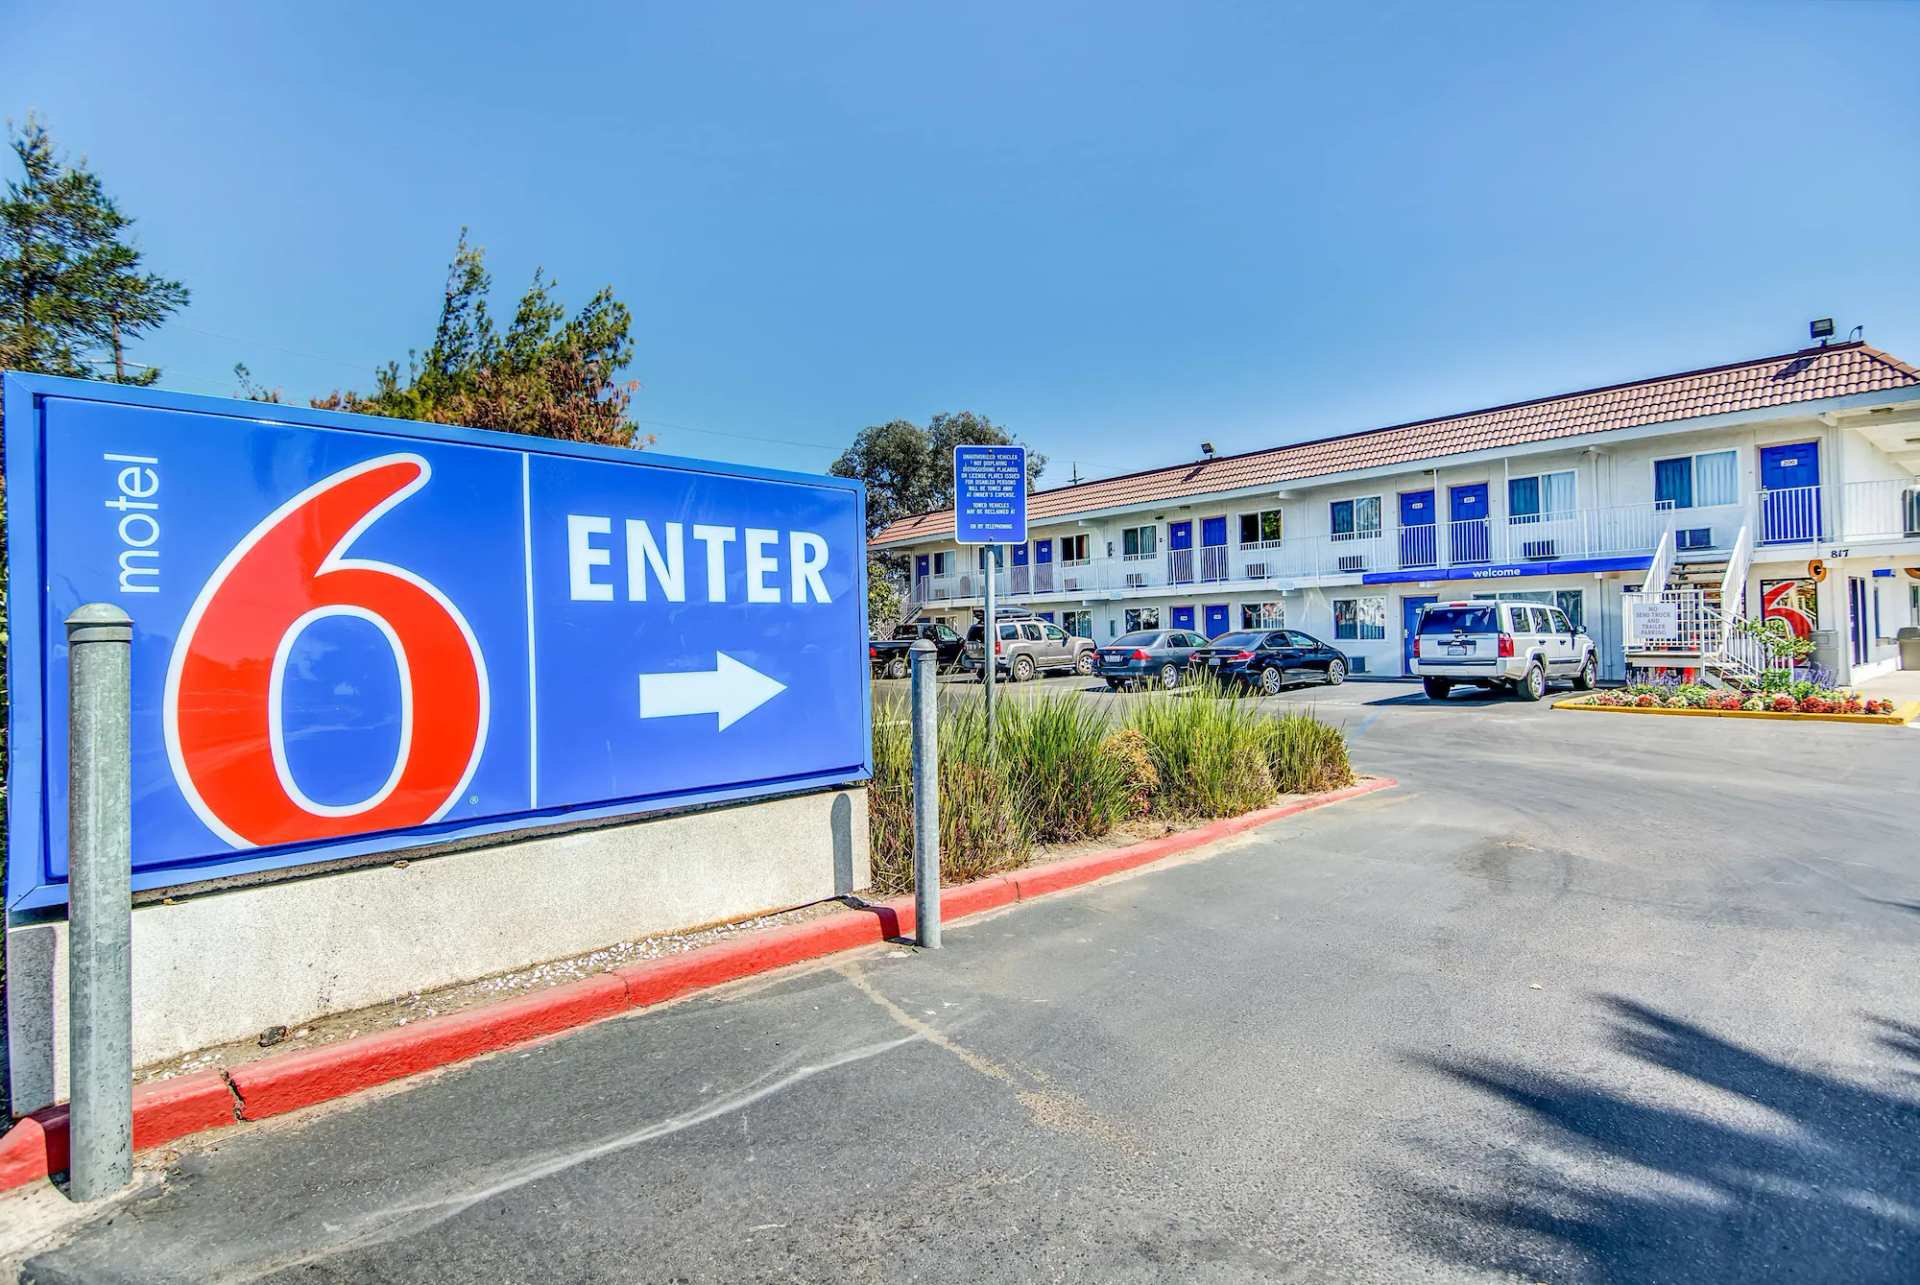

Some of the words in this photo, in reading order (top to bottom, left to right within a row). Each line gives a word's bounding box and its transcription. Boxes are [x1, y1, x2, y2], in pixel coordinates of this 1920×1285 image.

[104, 453, 160, 593] motel
[567, 514, 833, 604] ENTER
[1831, 549, 1850, 559] 817
[1472, 567, 1521, 578] welcome
[163, 452, 490, 850] 6
